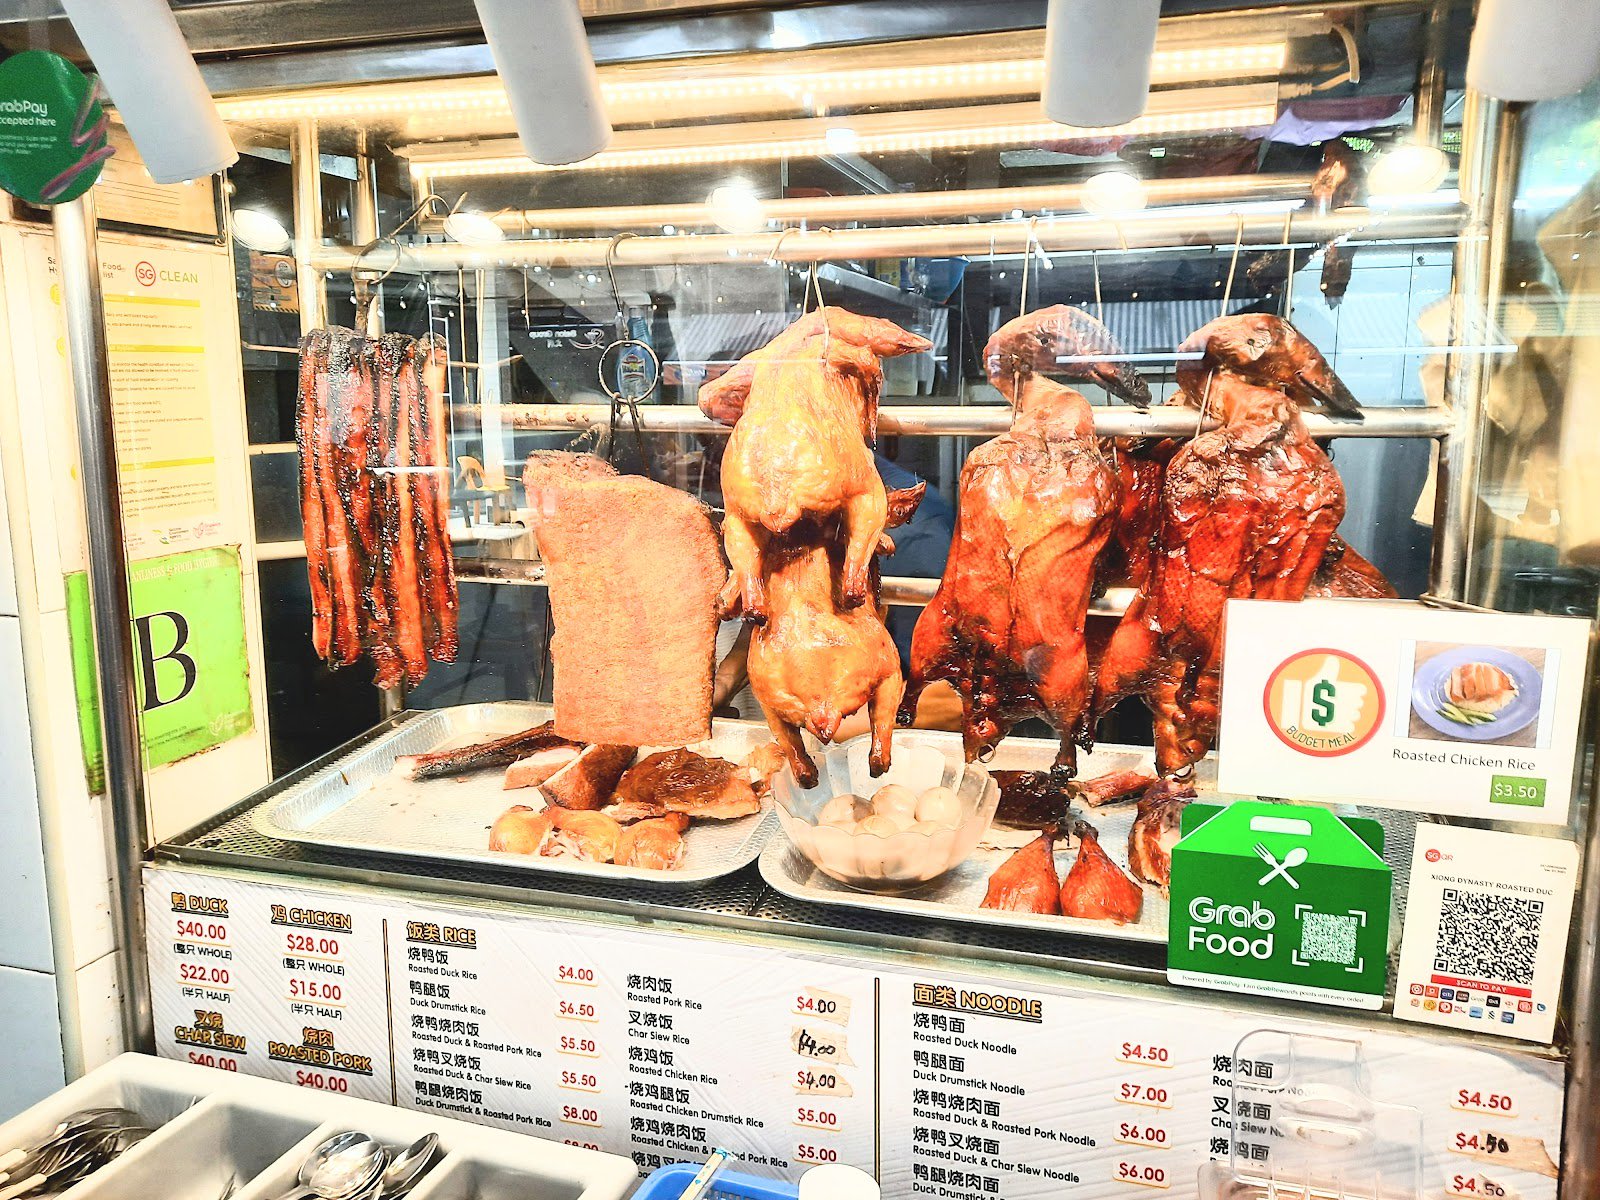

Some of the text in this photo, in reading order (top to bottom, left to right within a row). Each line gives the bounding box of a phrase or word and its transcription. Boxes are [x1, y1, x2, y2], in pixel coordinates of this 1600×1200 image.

[0, 100, 48, 117] rabPay
[36, 118, 56, 127] here
[138, 268, 198, 284] SG CLEAN
[134, 611, 197, 712] B
[1286, 726, 1358, 749] BUDGET MEAL
[1393, 748, 1536, 772] Roasted Chicken Rice
[1494, 782, 1538, 800] $3.50
[1426, 851, 1439, 861] SG
[1431, 874, 1554, 896] XIONG DYNASTY ROASTED DUC
[189, 895, 228, 914] DUCK
[1189, 897, 1276, 931] Grab
[271, 904, 352, 930] 鸡 CHICKEN
[177, 920, 226, 940] $40.00
[406, 921, 477, 945] 饭类 RICE
[287, 934, 339, 955] $28.00
[1189, 926, 1274, 960] Food
[408, 946, 449, 965] 烧鸭饭
[180, 963, 230, 984] $22.00
[408, 964, 478, 981] Roasted Duck Rice
[559, 966, 594, 982] $4.00
[290, 979, 342, 1001] $15.00
[627, 974, 673, 995] 烧肉饭
[1457, 980, 1478, 989] SCAN
[1491, 985, 1507, 993] PAY
[410, 998, 487, 1016] Duck Drumstick Rice
[560, 1001, 595, 1017] $6.50
[627, 992, 703, 1011] Roasted Pork Rice
[797, 996, 837, 1014] $4.00
[914, 983, 1043, 1018] 面类 NOODLE
[628, 1010, 673, 1031] 叉烧饭
[913, 1012, 965, 1034] 烧鸭面
[175, 1026, 247, 1050] CHAR SIEW
[303, 1027, 334, 1048] 烧肉
[412, 1031, 542, 1058] Roasted Duck & Roasted Pork Rice
[561, 1036, 596, 1053] $5.50
[628, 1028, 690, 1045] Char Siew Rice
[914, 1031, 1017, 1055] Roasted Duck Noodle
[269, 1041, 373, 1072] ROASTED PORK
[628, 1045, 675, 1067] 烧鸡饭
[1122, 1042, 1169, 1062] $4.50
[296, 1070, 348, 1093] $40.00
[414, 1064, 532, 1091] Roasted Duck & Char Siew Rice
[562, 1071, 597, 1087] $5.50
[629, 1064, 718, 1085] Roasted Chicken Rice
[798, 1071, 837, 1090] $4.00
[913, 1070, 1026, 1096] Duck Drumstick Noodle
[913, 1088, 1001, 1117] 烧鸭烧肉面
[1121, 1083, 1168, 1103] $7.00
[1458, 1089, 1512, 1111] $4.50
[415, 1097, 552, 1128] Duck Drumstick & Roasted Pork Rice
[563, 1105, 598, 1123] $8.00
[630, 1099, 764, 1129] Roasted Chicken Drumstick Rice
[798, 1108, 837, 1126] $5.00
[630, 1116, 707, 1143] 烧鸡烧肉饭
[913, 1107, 1096, 1148] Roasted Duck & Roasted Pork Noodle
[1120, 1123, 1166, 1143] $6.00
[631, 1134, 665, 1147] Roasted
[666, 1140, 700, 1154] Chicken
[702, 1146, 709, 1154] &
[913, 1126, 1000, 1155] 烧鸭叉烧面
[1456, 1132, 1510, 1154] $4.50
[748, 1154, 789, 1168] Pork Rice
[798, 1144, 837, 1162] $5.00
[913, 1145, 1080, 1184] Roasted Duck & Char Siew Noodle
[1119, 1162, 1165, 1182] $6.00
[913, 1182, 937, 1195] Duck
[1453, 1175, 1506, 1197] $4.50
